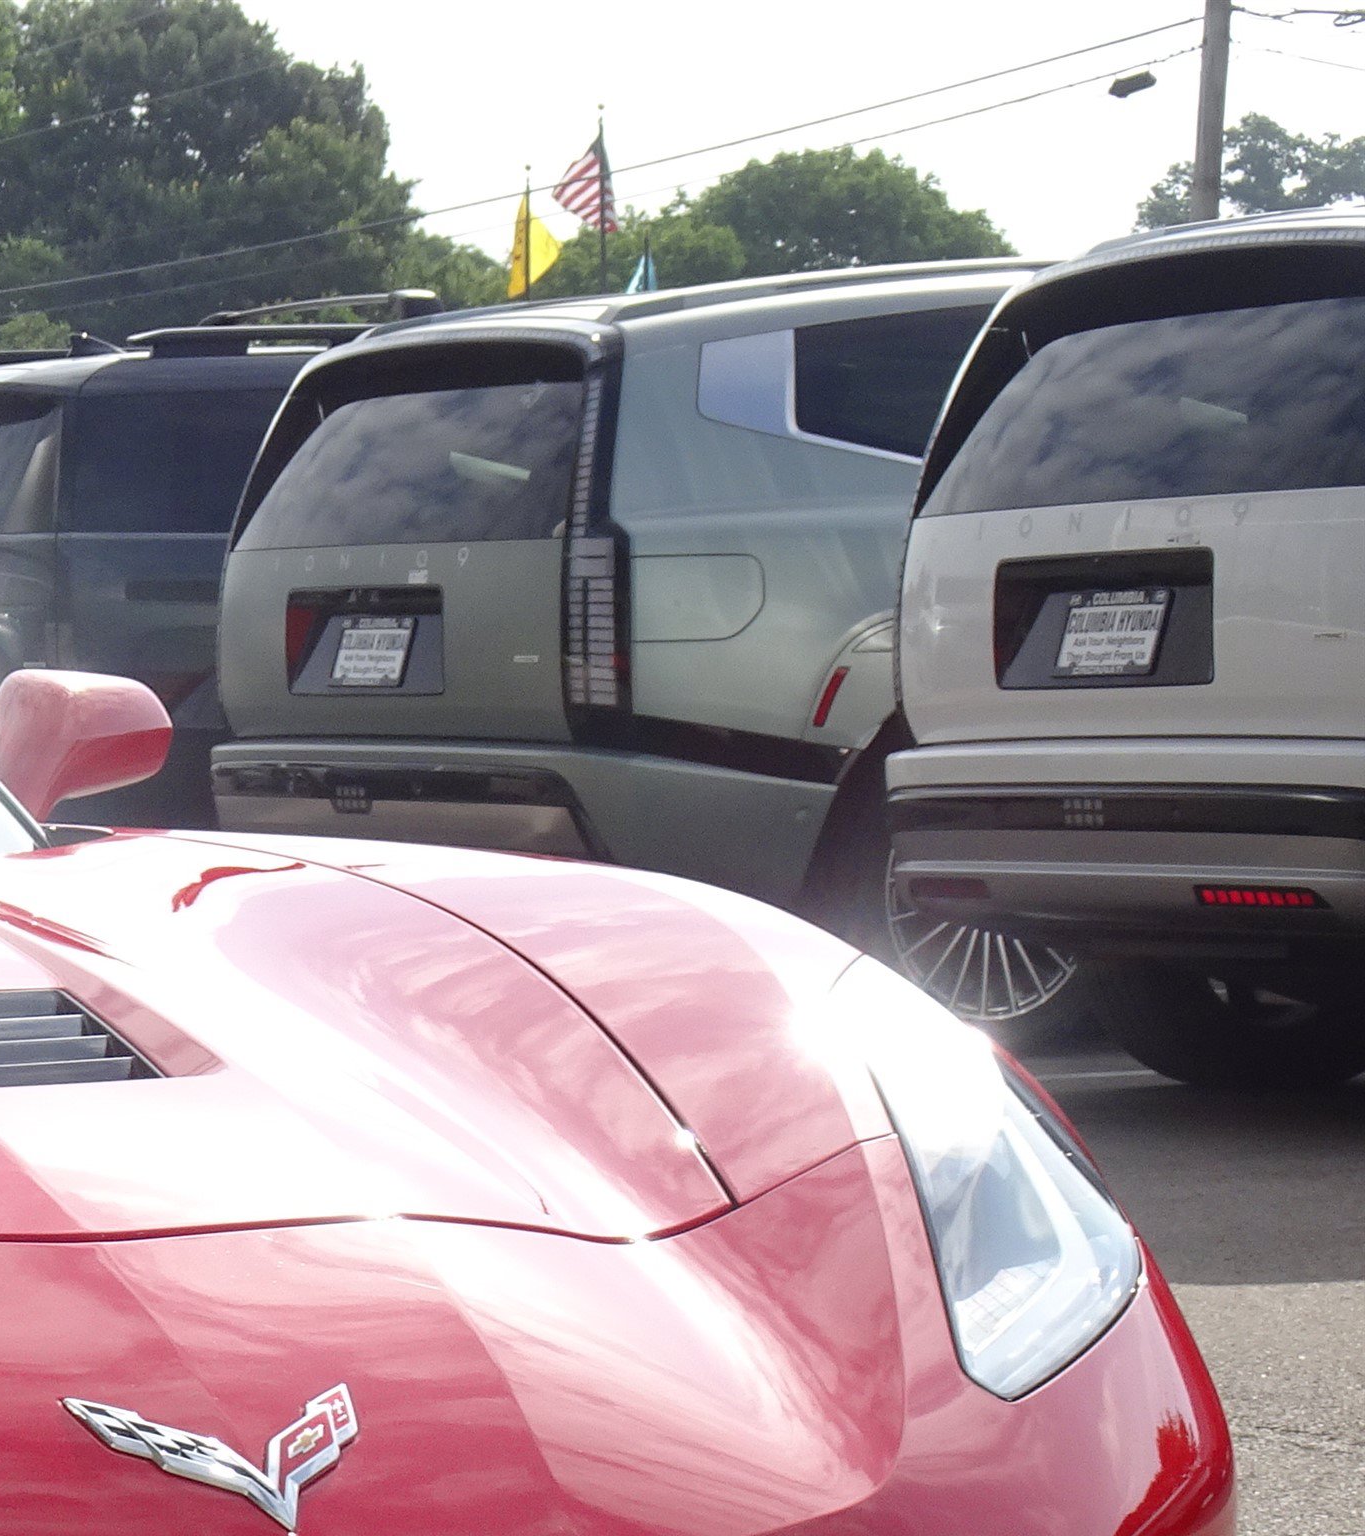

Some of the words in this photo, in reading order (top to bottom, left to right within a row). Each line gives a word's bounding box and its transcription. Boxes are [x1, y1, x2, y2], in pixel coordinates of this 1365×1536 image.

[458, 547, 469, 567] 9
[1068, 610, 1118, 634] COLUMBIA
[1072, 636, 1087, 646] Ask
[1088, 637, 1106, 646] Your
[1106, 635, 1146, 648] Neighbors
[1114, 650, 1134, 660] From
